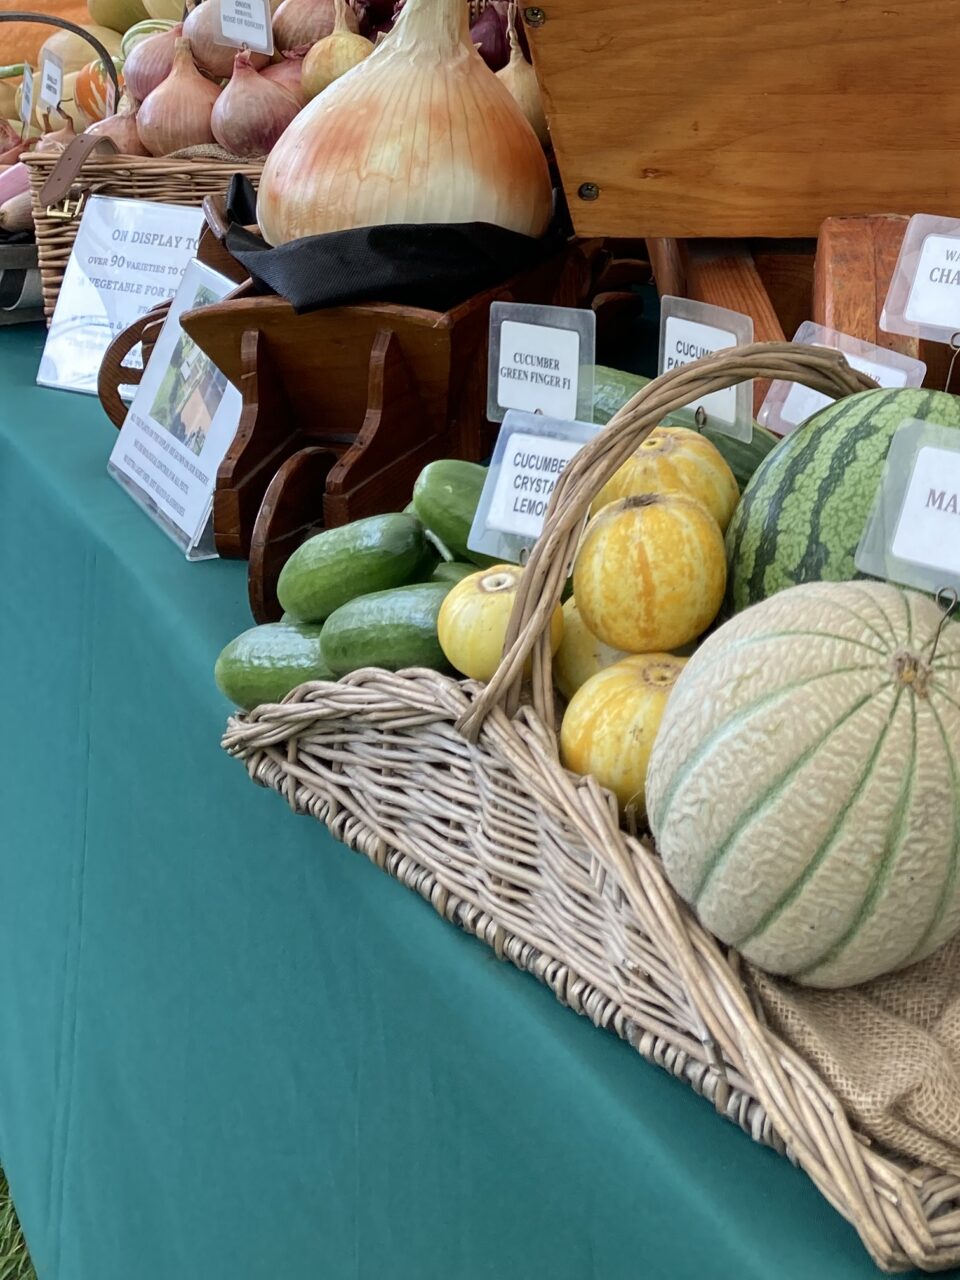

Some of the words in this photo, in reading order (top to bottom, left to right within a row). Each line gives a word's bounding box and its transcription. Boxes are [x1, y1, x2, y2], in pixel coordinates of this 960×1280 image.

[235, 0, 252, 10] ONION
[112, 229, 128, 241] ON
[131, 231, 182, 249] DISPLAY
[88, 256, 109, 266] OVER
[110, 255, 125, 268] 90
[126, 261, 165, 275] VARIETIES
[168, 267, 178, 275] TO
[144, 286, 165, 297] FOR
[513, 352, 560, 371] CUCUMBER
[500, 366, 528, 381] GREEN
[530, 371, 560, 388] FINGER
[562, 377, 571, 390] F1
[513, 452, 569, 473] CUCUMBE
[513, 474, 555, 495] CRYSTA
